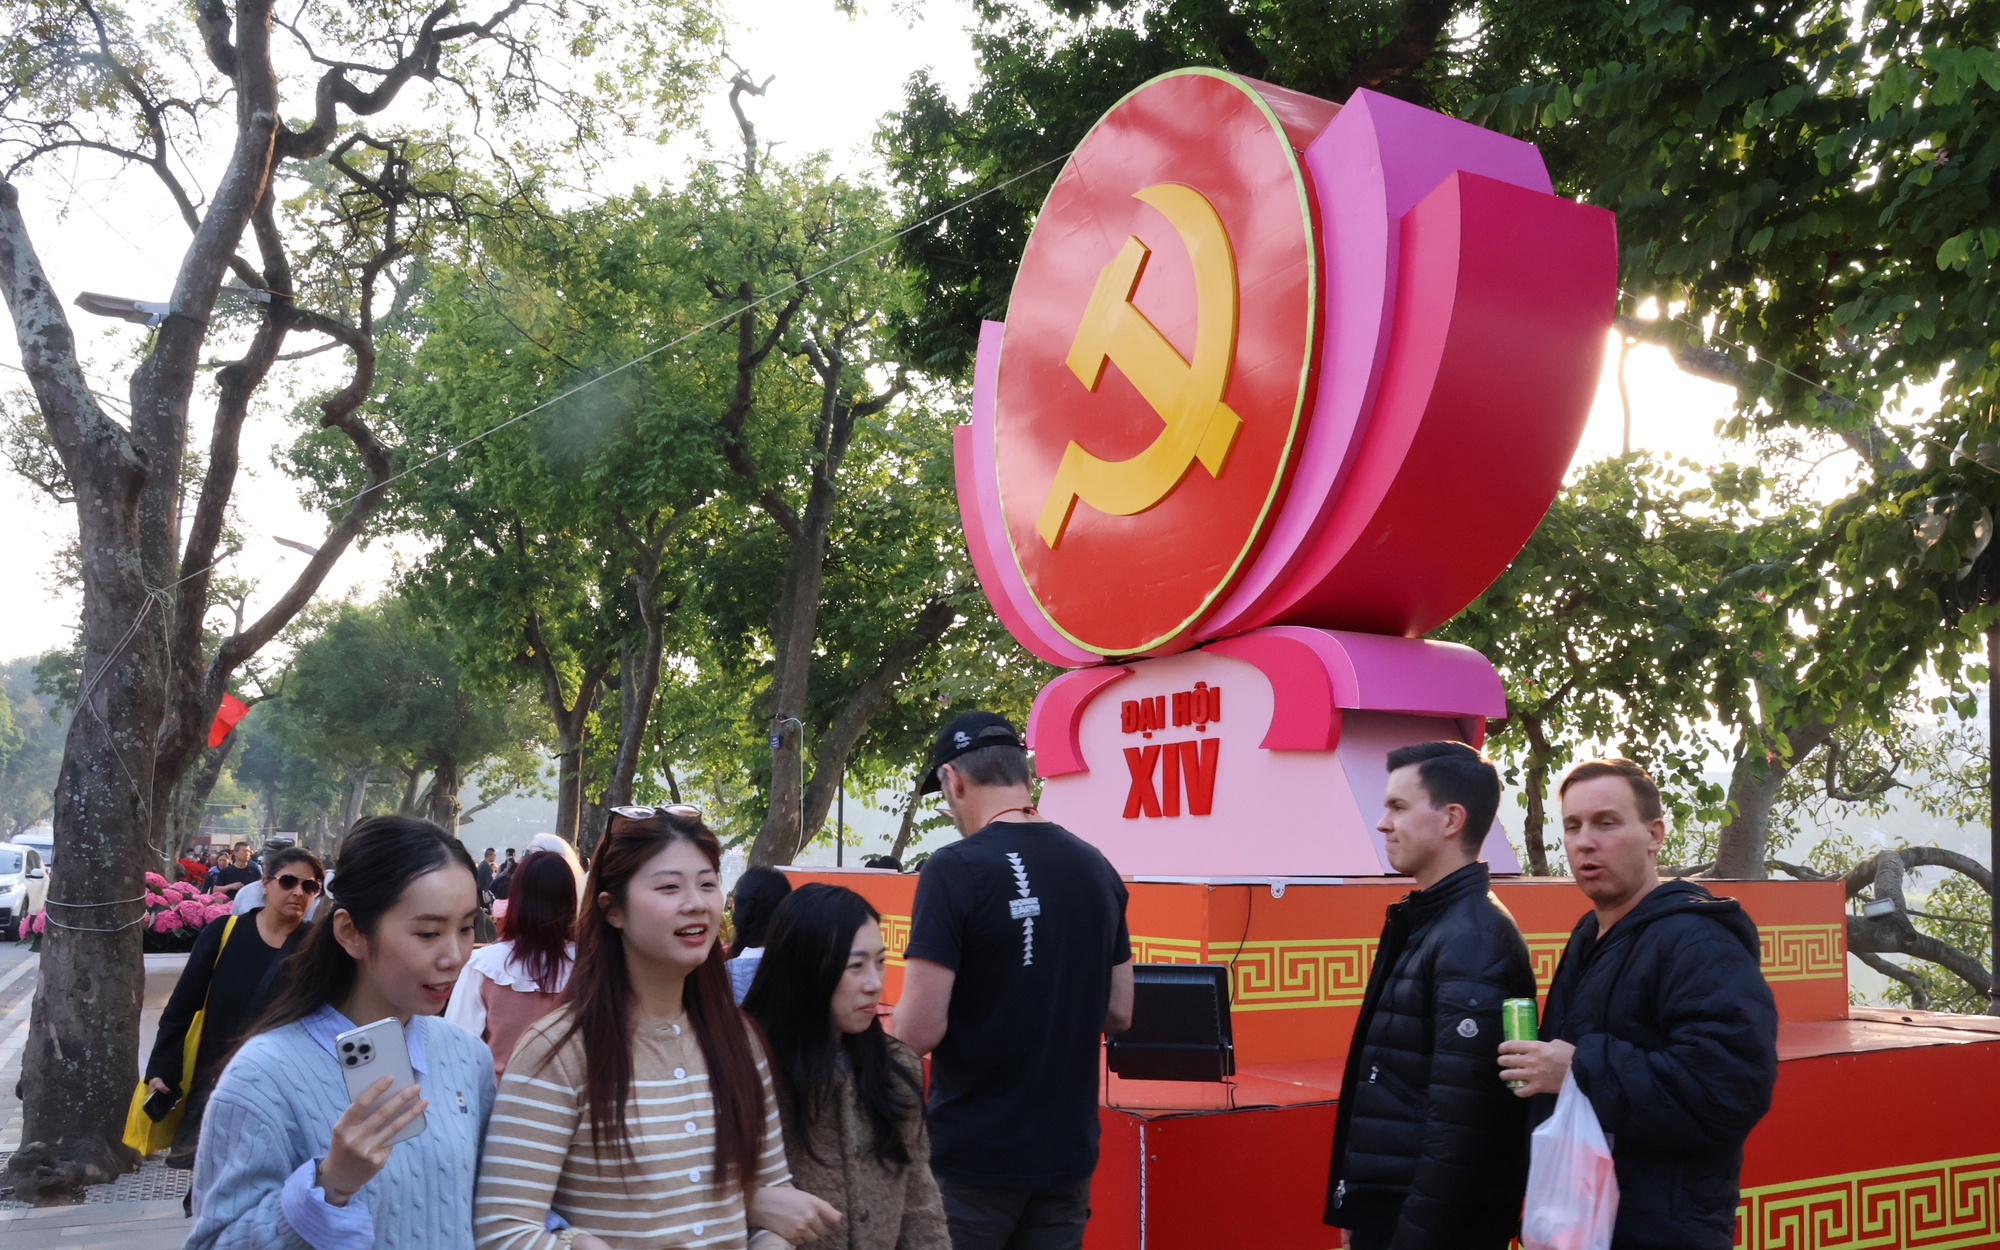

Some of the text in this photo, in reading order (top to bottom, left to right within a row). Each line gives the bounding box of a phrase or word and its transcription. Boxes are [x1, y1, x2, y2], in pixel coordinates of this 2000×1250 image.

[1121, 681, 1221, 739] ĐẠI HỘI
[1122, 738, 1220, 819] XIV
